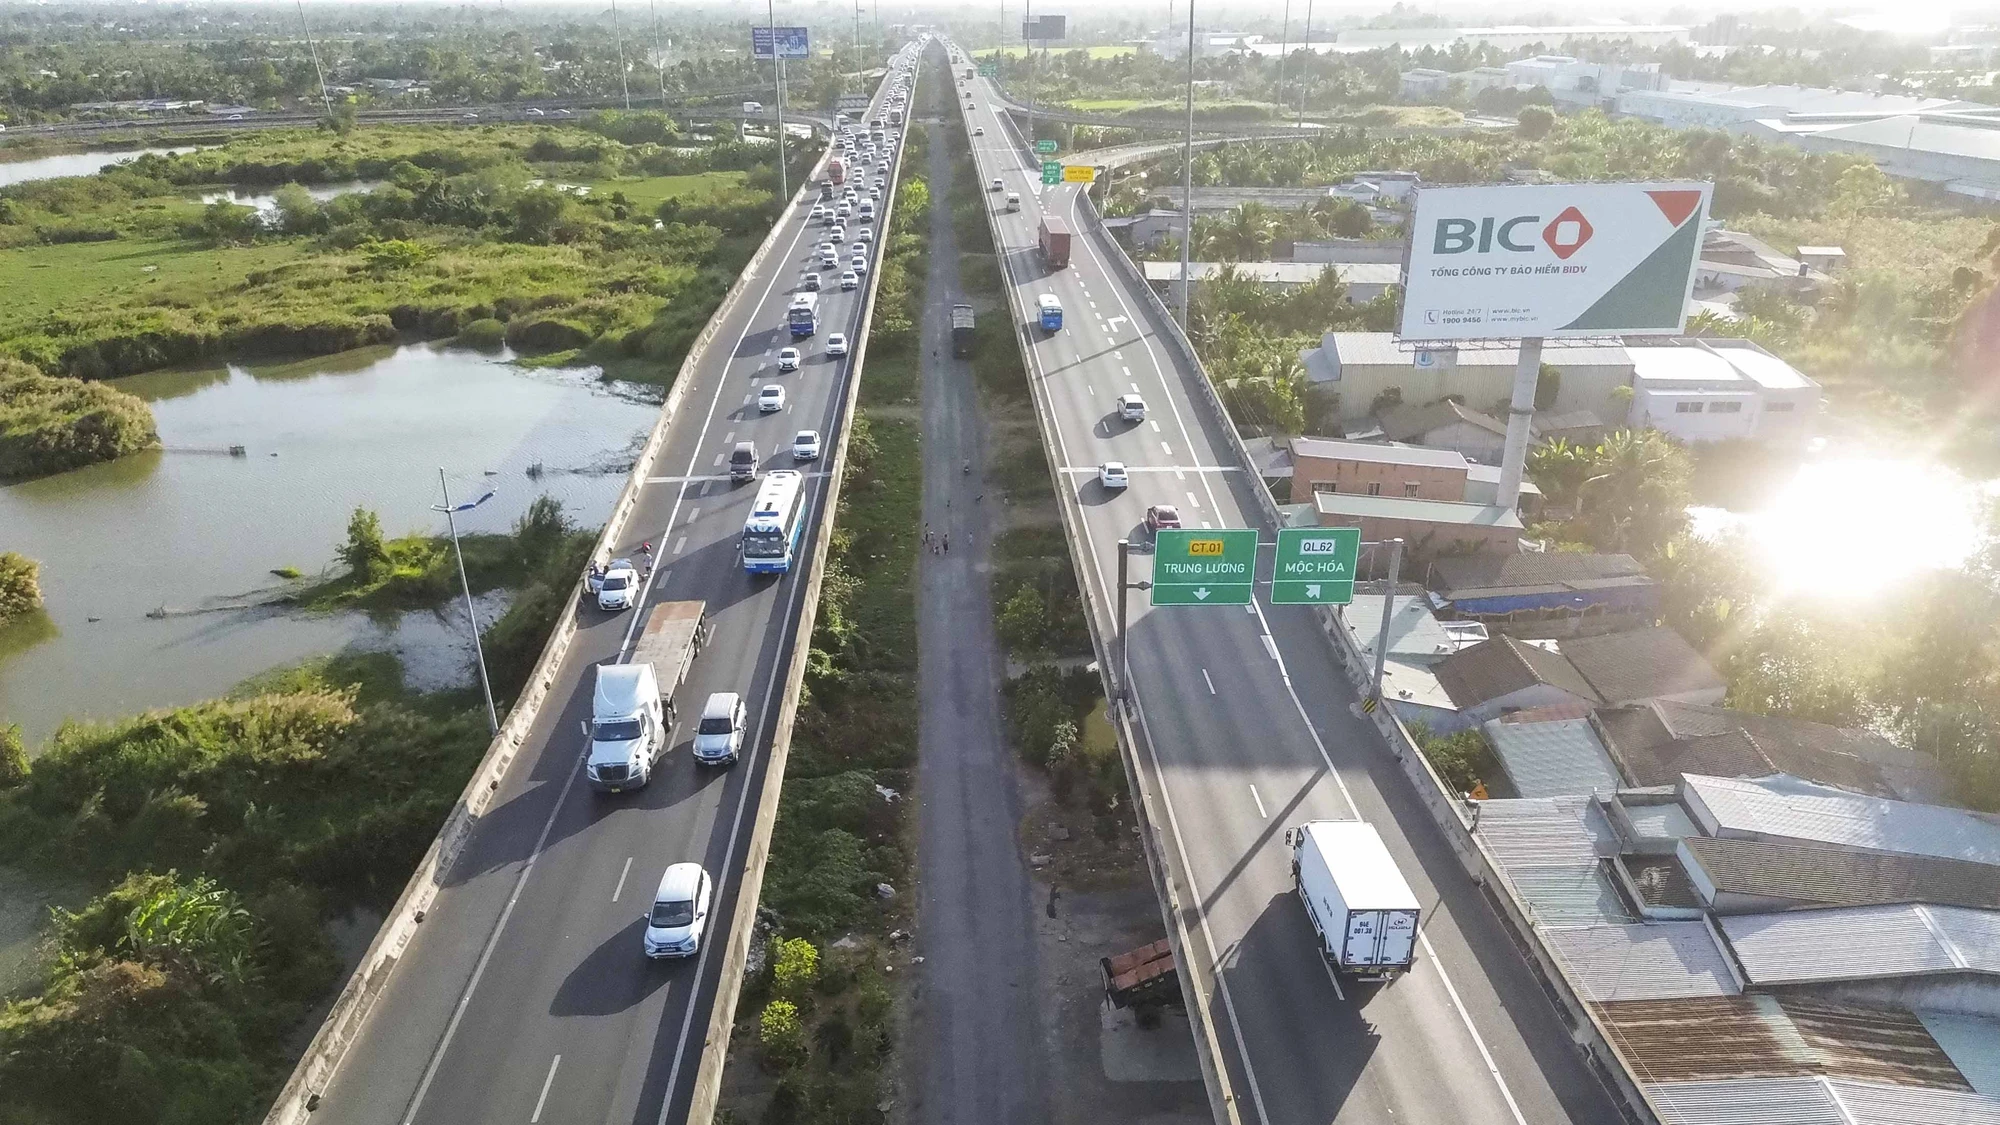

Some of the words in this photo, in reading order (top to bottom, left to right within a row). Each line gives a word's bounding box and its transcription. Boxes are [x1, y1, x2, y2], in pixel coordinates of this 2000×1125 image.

[1433, 216, 1540, 255] BIC
[1462, 266, 1491, 276] CÔNG
[1495, 267, 1508, 275] TY
[1510, 264, 1532, 275] BẢO
[1562, 265, 1588, 274] BIDV
[1191, 542, 1221, 553] CT.01
[1164, 563, 1202, 574] TRUNG
[1205, 562, 1245, 574] LƯƠNG
[1285, 560, 1314, 575] MỘC
[1317, 559, 1345, 573] HÓA
